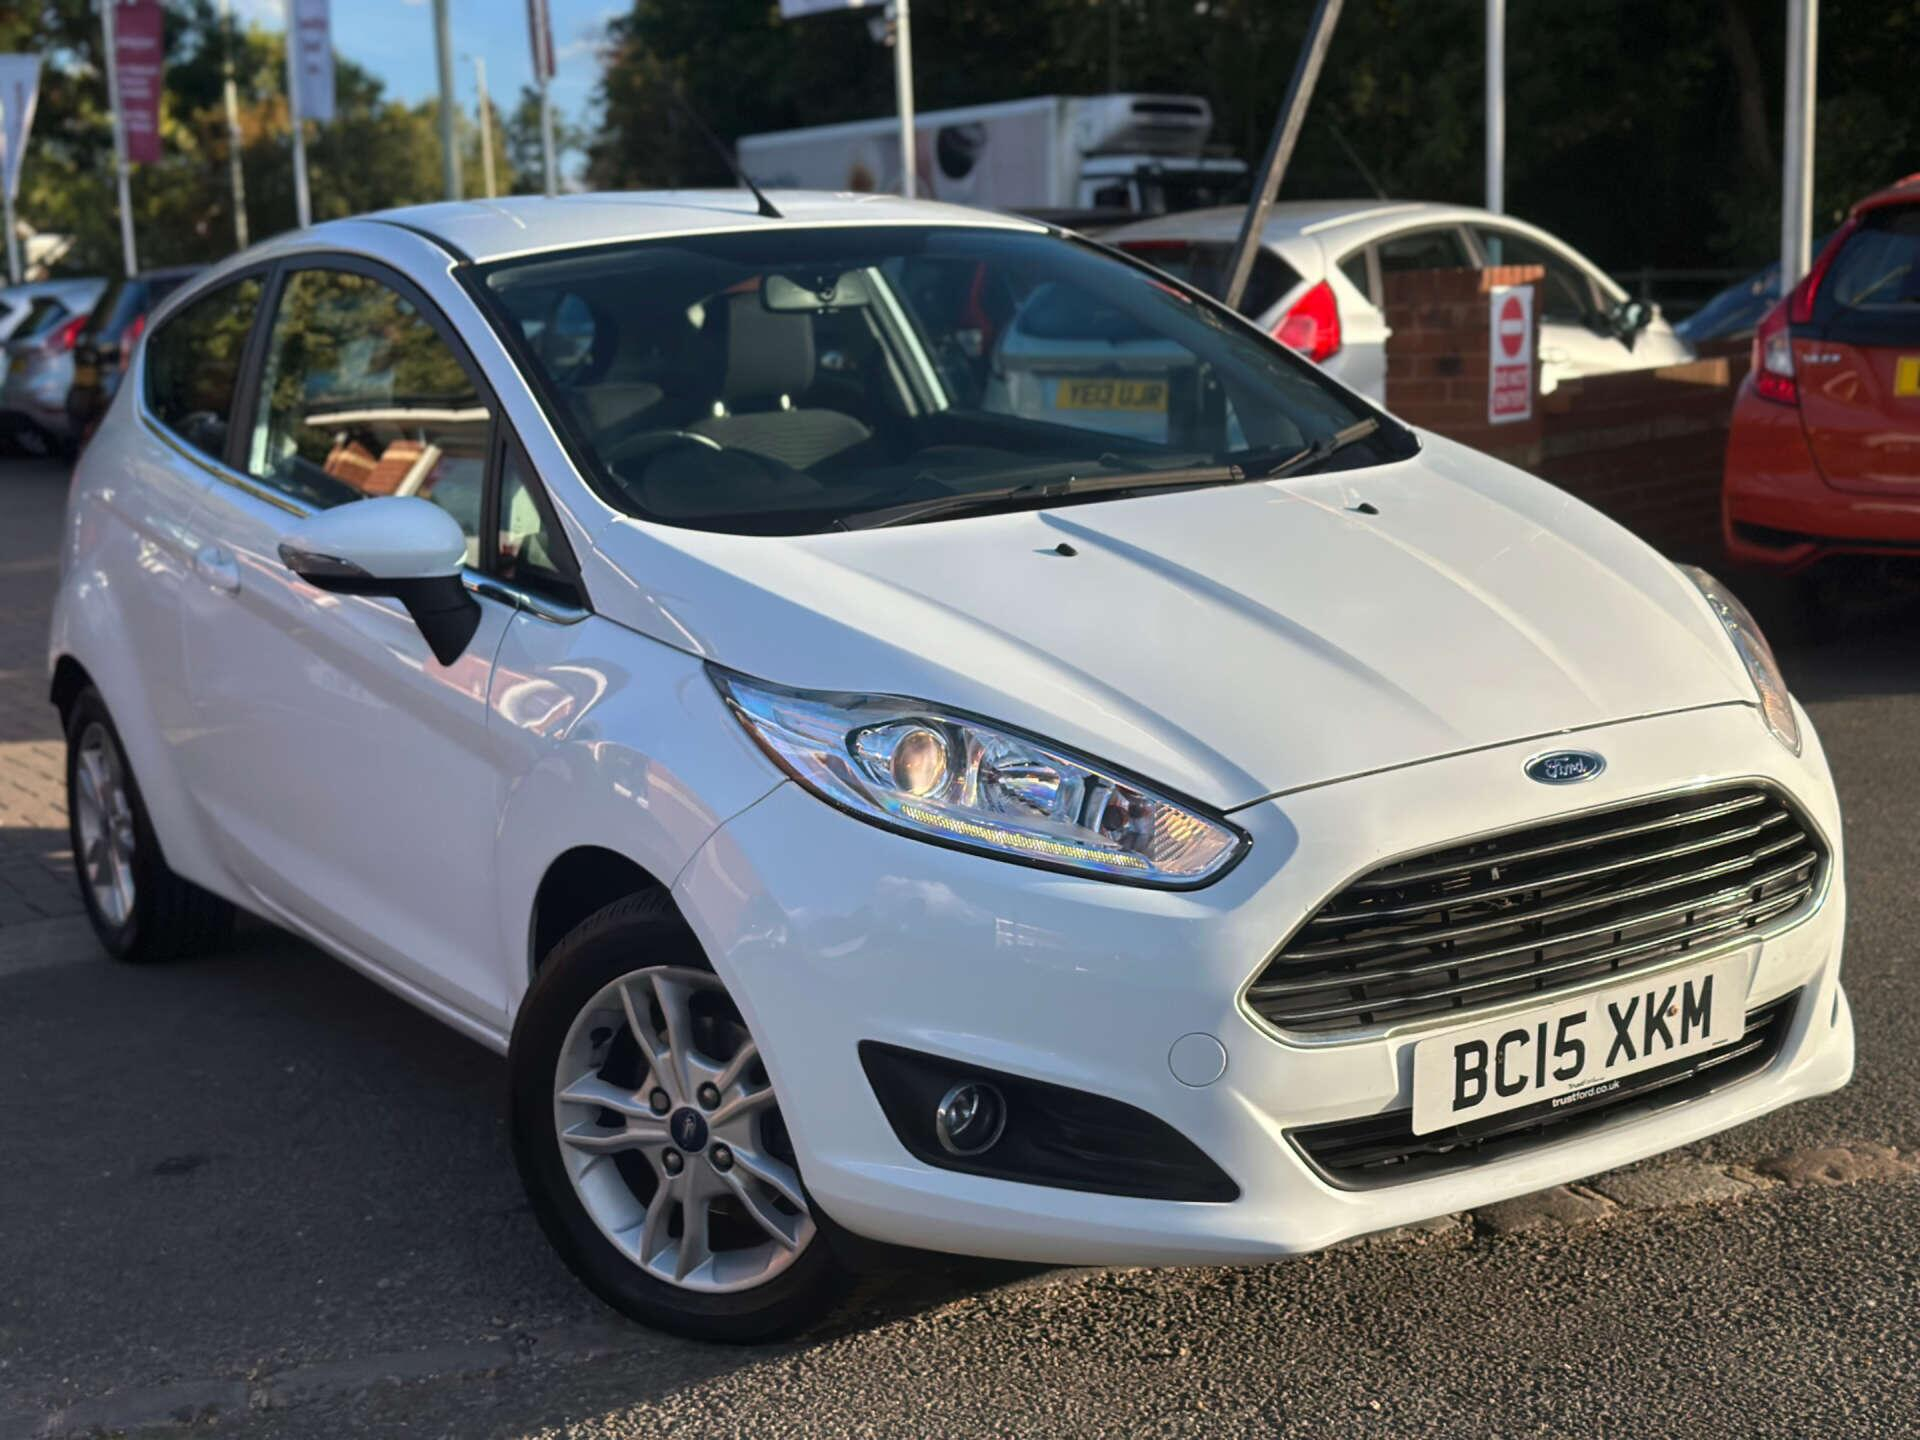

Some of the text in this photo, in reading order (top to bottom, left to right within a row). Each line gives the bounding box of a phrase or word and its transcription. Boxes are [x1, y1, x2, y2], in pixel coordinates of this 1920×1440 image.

[1544, 757, 1587, 779] Ford
[1452, 974, 1714, 1112] BC15 XKM
[1551, 1080, 1621, 1108] trustford.co.uk
